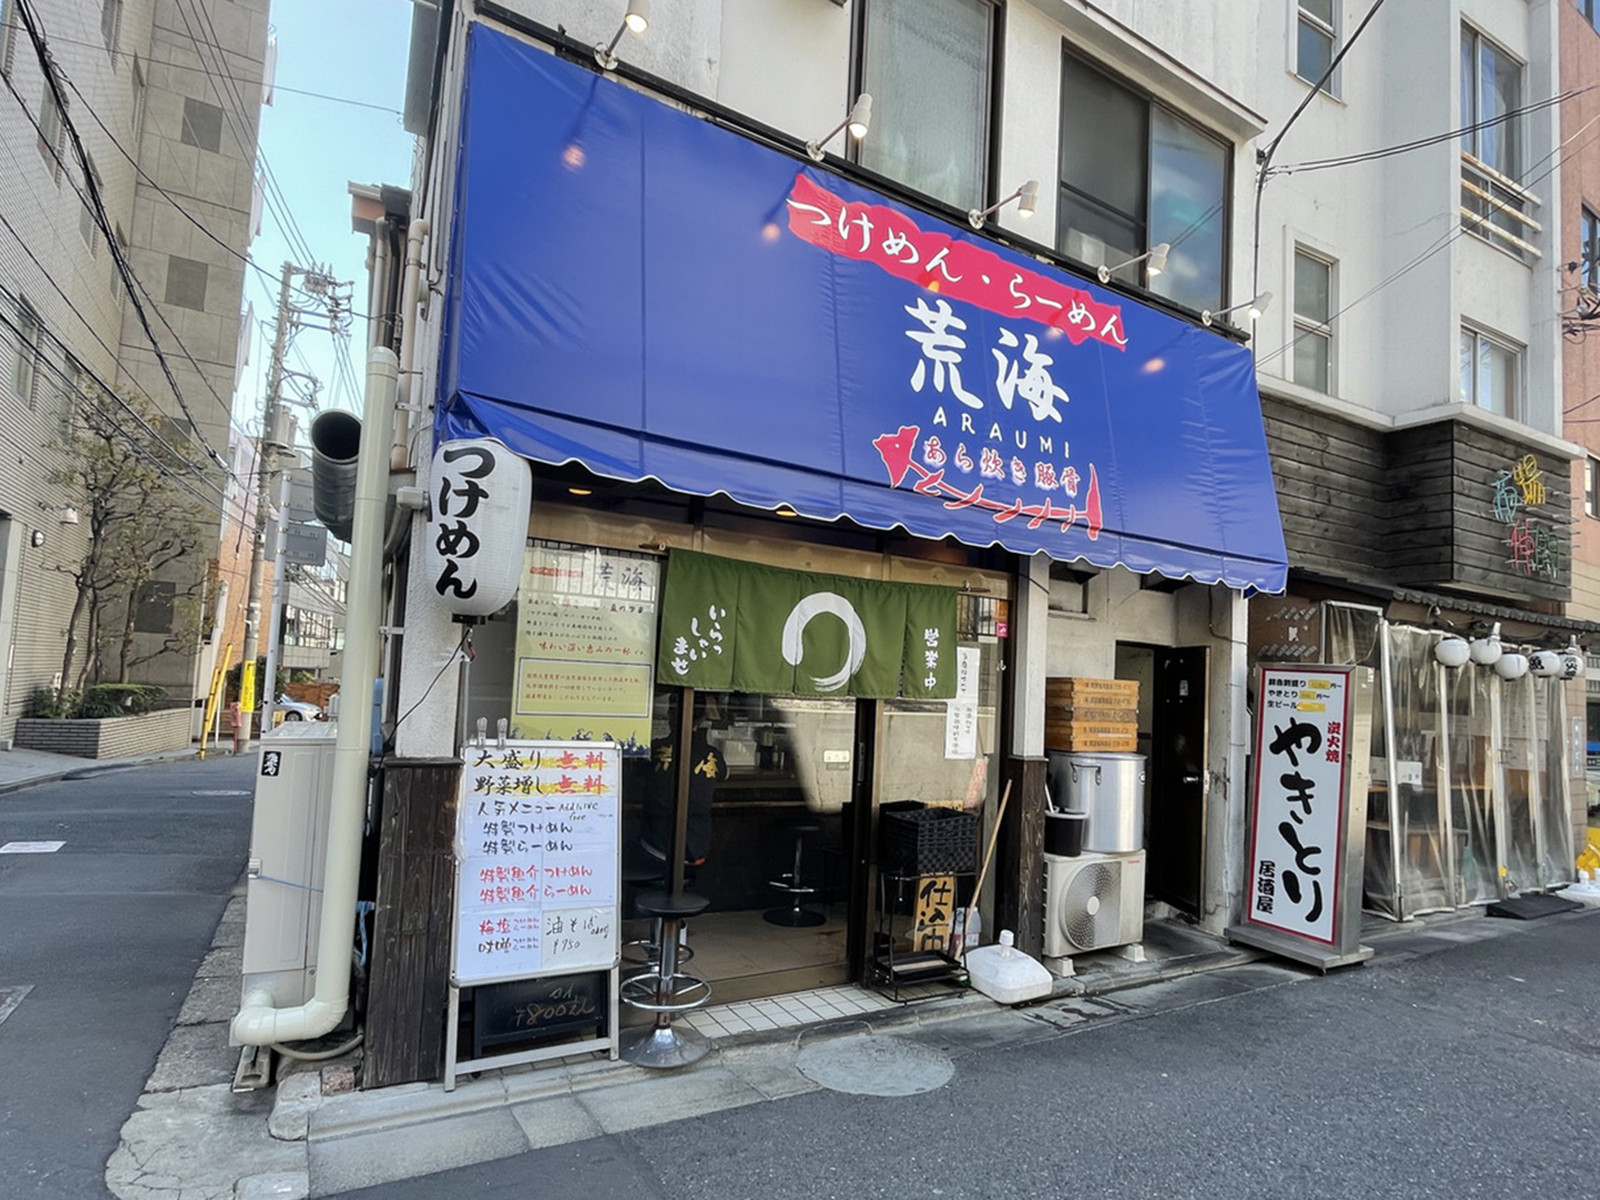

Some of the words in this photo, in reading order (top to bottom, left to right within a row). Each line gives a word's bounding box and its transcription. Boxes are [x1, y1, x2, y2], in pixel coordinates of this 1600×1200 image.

[786, 197, 1129, 345] つけめん・らーめん
[904, 297, 1071, 424] 荒海
[932, 405, 1070, 459] ARAUMI
[923, 435, 1081, 498] あら炊き豚骨
[435, 447, 496, 599] つけめん
[671, 635, 689, 675] ませ
[924, 627, 940, 691] 営業中
[473, 749, 541, 770] 大盛り
[556, 750, 606, 771] 無料
[1325, 721, 1341, 763] 炭火焼
[474, 775, 544, 796] 野菜増し
[555, 774, 605, 795] 無料
[478, 800, 555, 816] 人気メニュー
[483, 819, 573, 837] 特製つけめん
[1269, 717, 1322, 923] やきとり
[483, 838, 573, 855] 特製らーめん
[480, 864, 539, 884] 特製魚介
[543, 865, 593, 879] つけめん
[480, 883, 539, 903] 特製魚介
[543, 884, 592, 899] らーめん
[1256, 859, 1275, 915] 居酒屋
